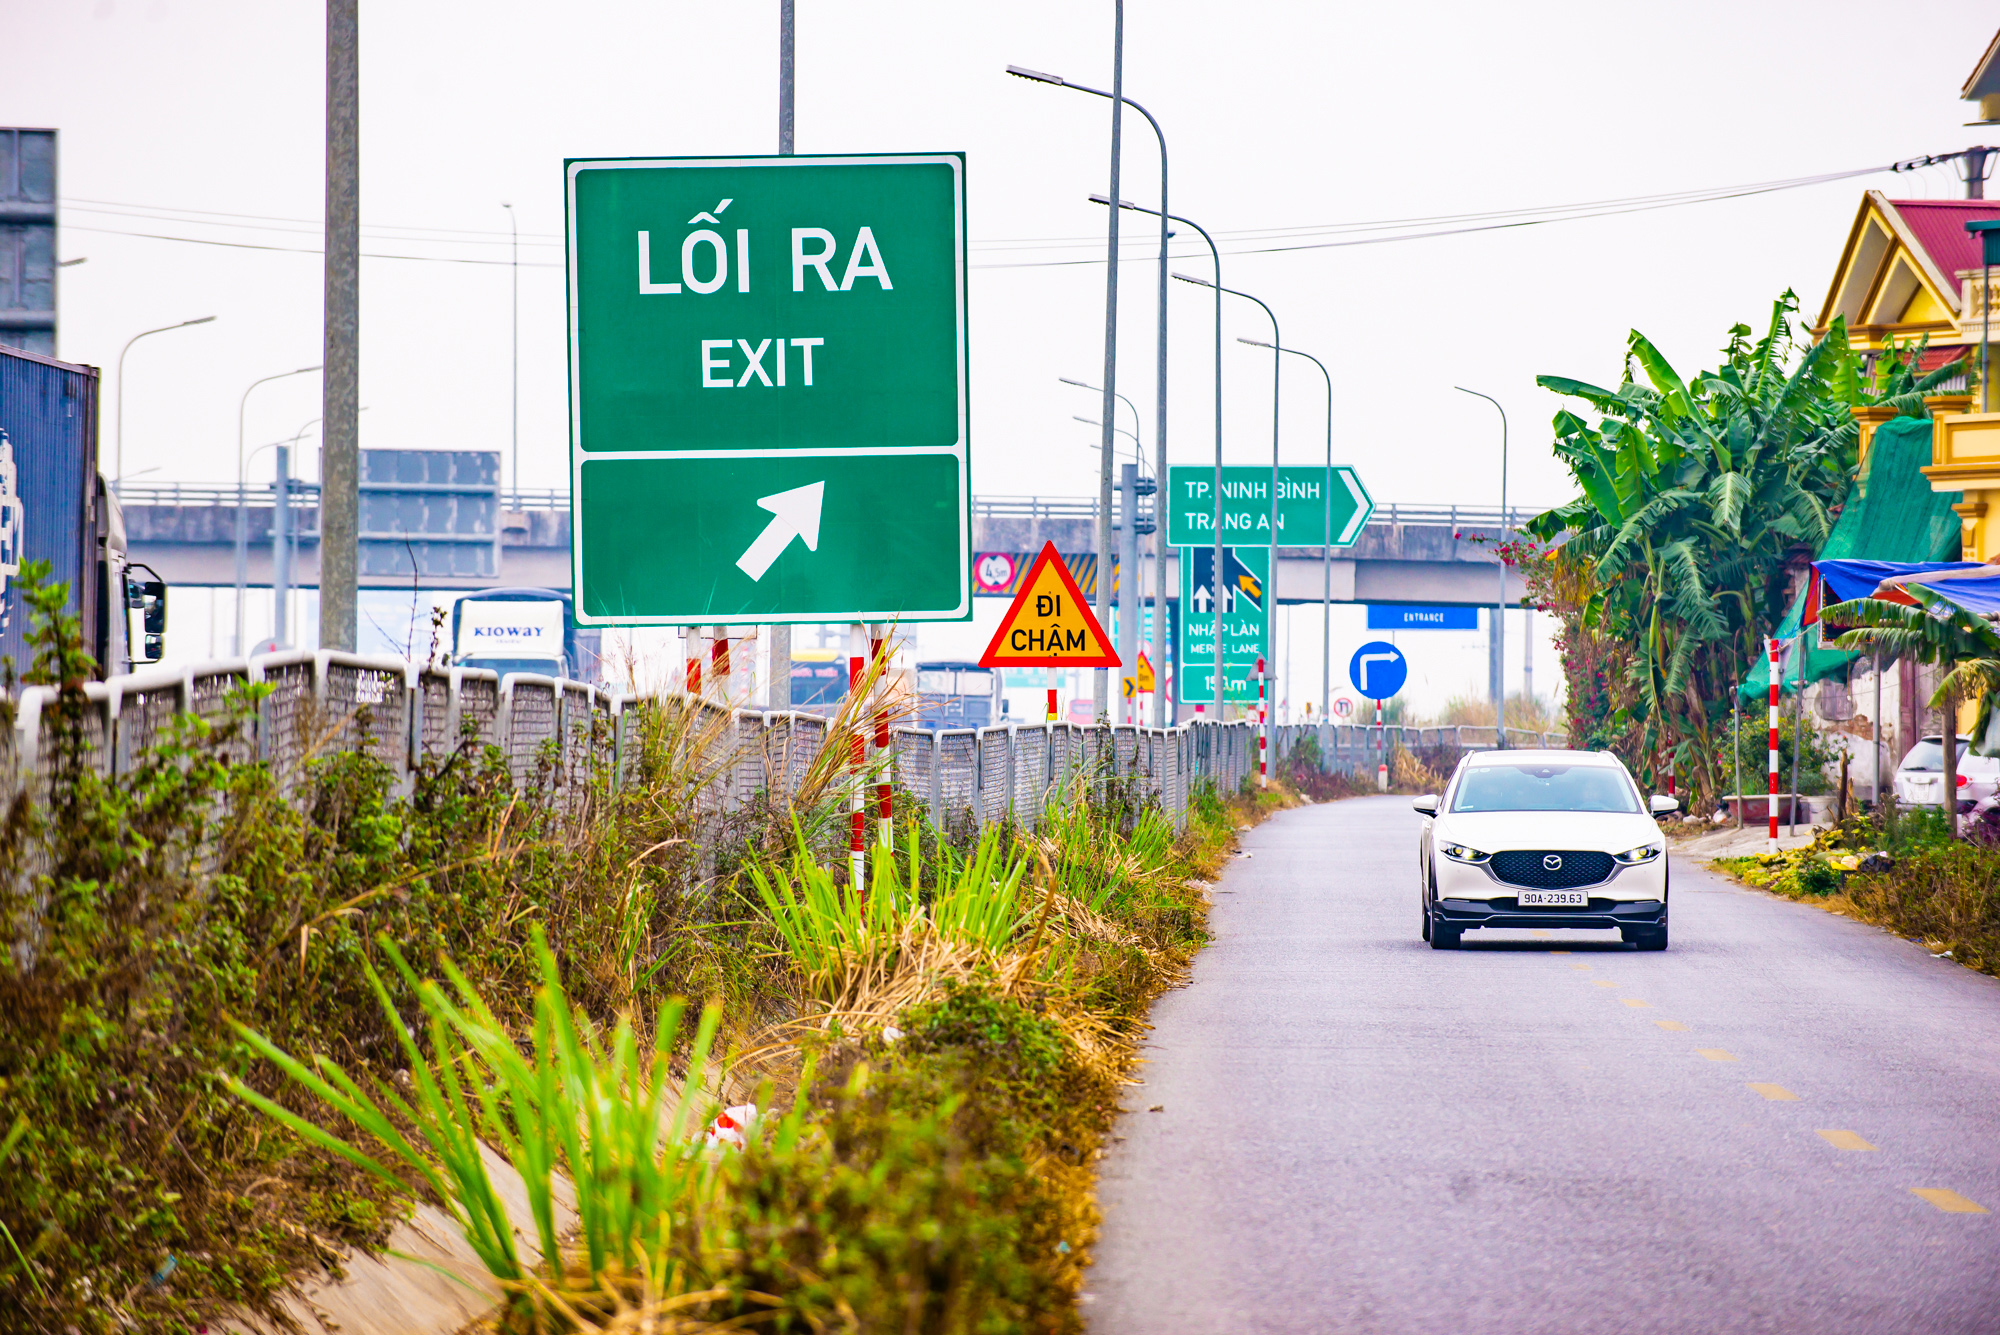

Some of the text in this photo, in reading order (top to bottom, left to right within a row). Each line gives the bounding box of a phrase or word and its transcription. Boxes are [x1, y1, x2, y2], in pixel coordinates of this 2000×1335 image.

[637, 198, 894, 295] LỐI RA
[701, 337, 825, 388] EXIT
[1184, 475, 1320, 499] TP. NINH BÌNH
[1036, 594, 1061, 617] ĐI
[1404, 612, 1444, 622] ENTRANCE
[1230, 618, 1259, 636] LÀN
[1011, 623, 1086, 657] CHẬM
[1231, 643, 1260, 654] LANE
[1524, 894, 1582, 904] 90A-239.63
